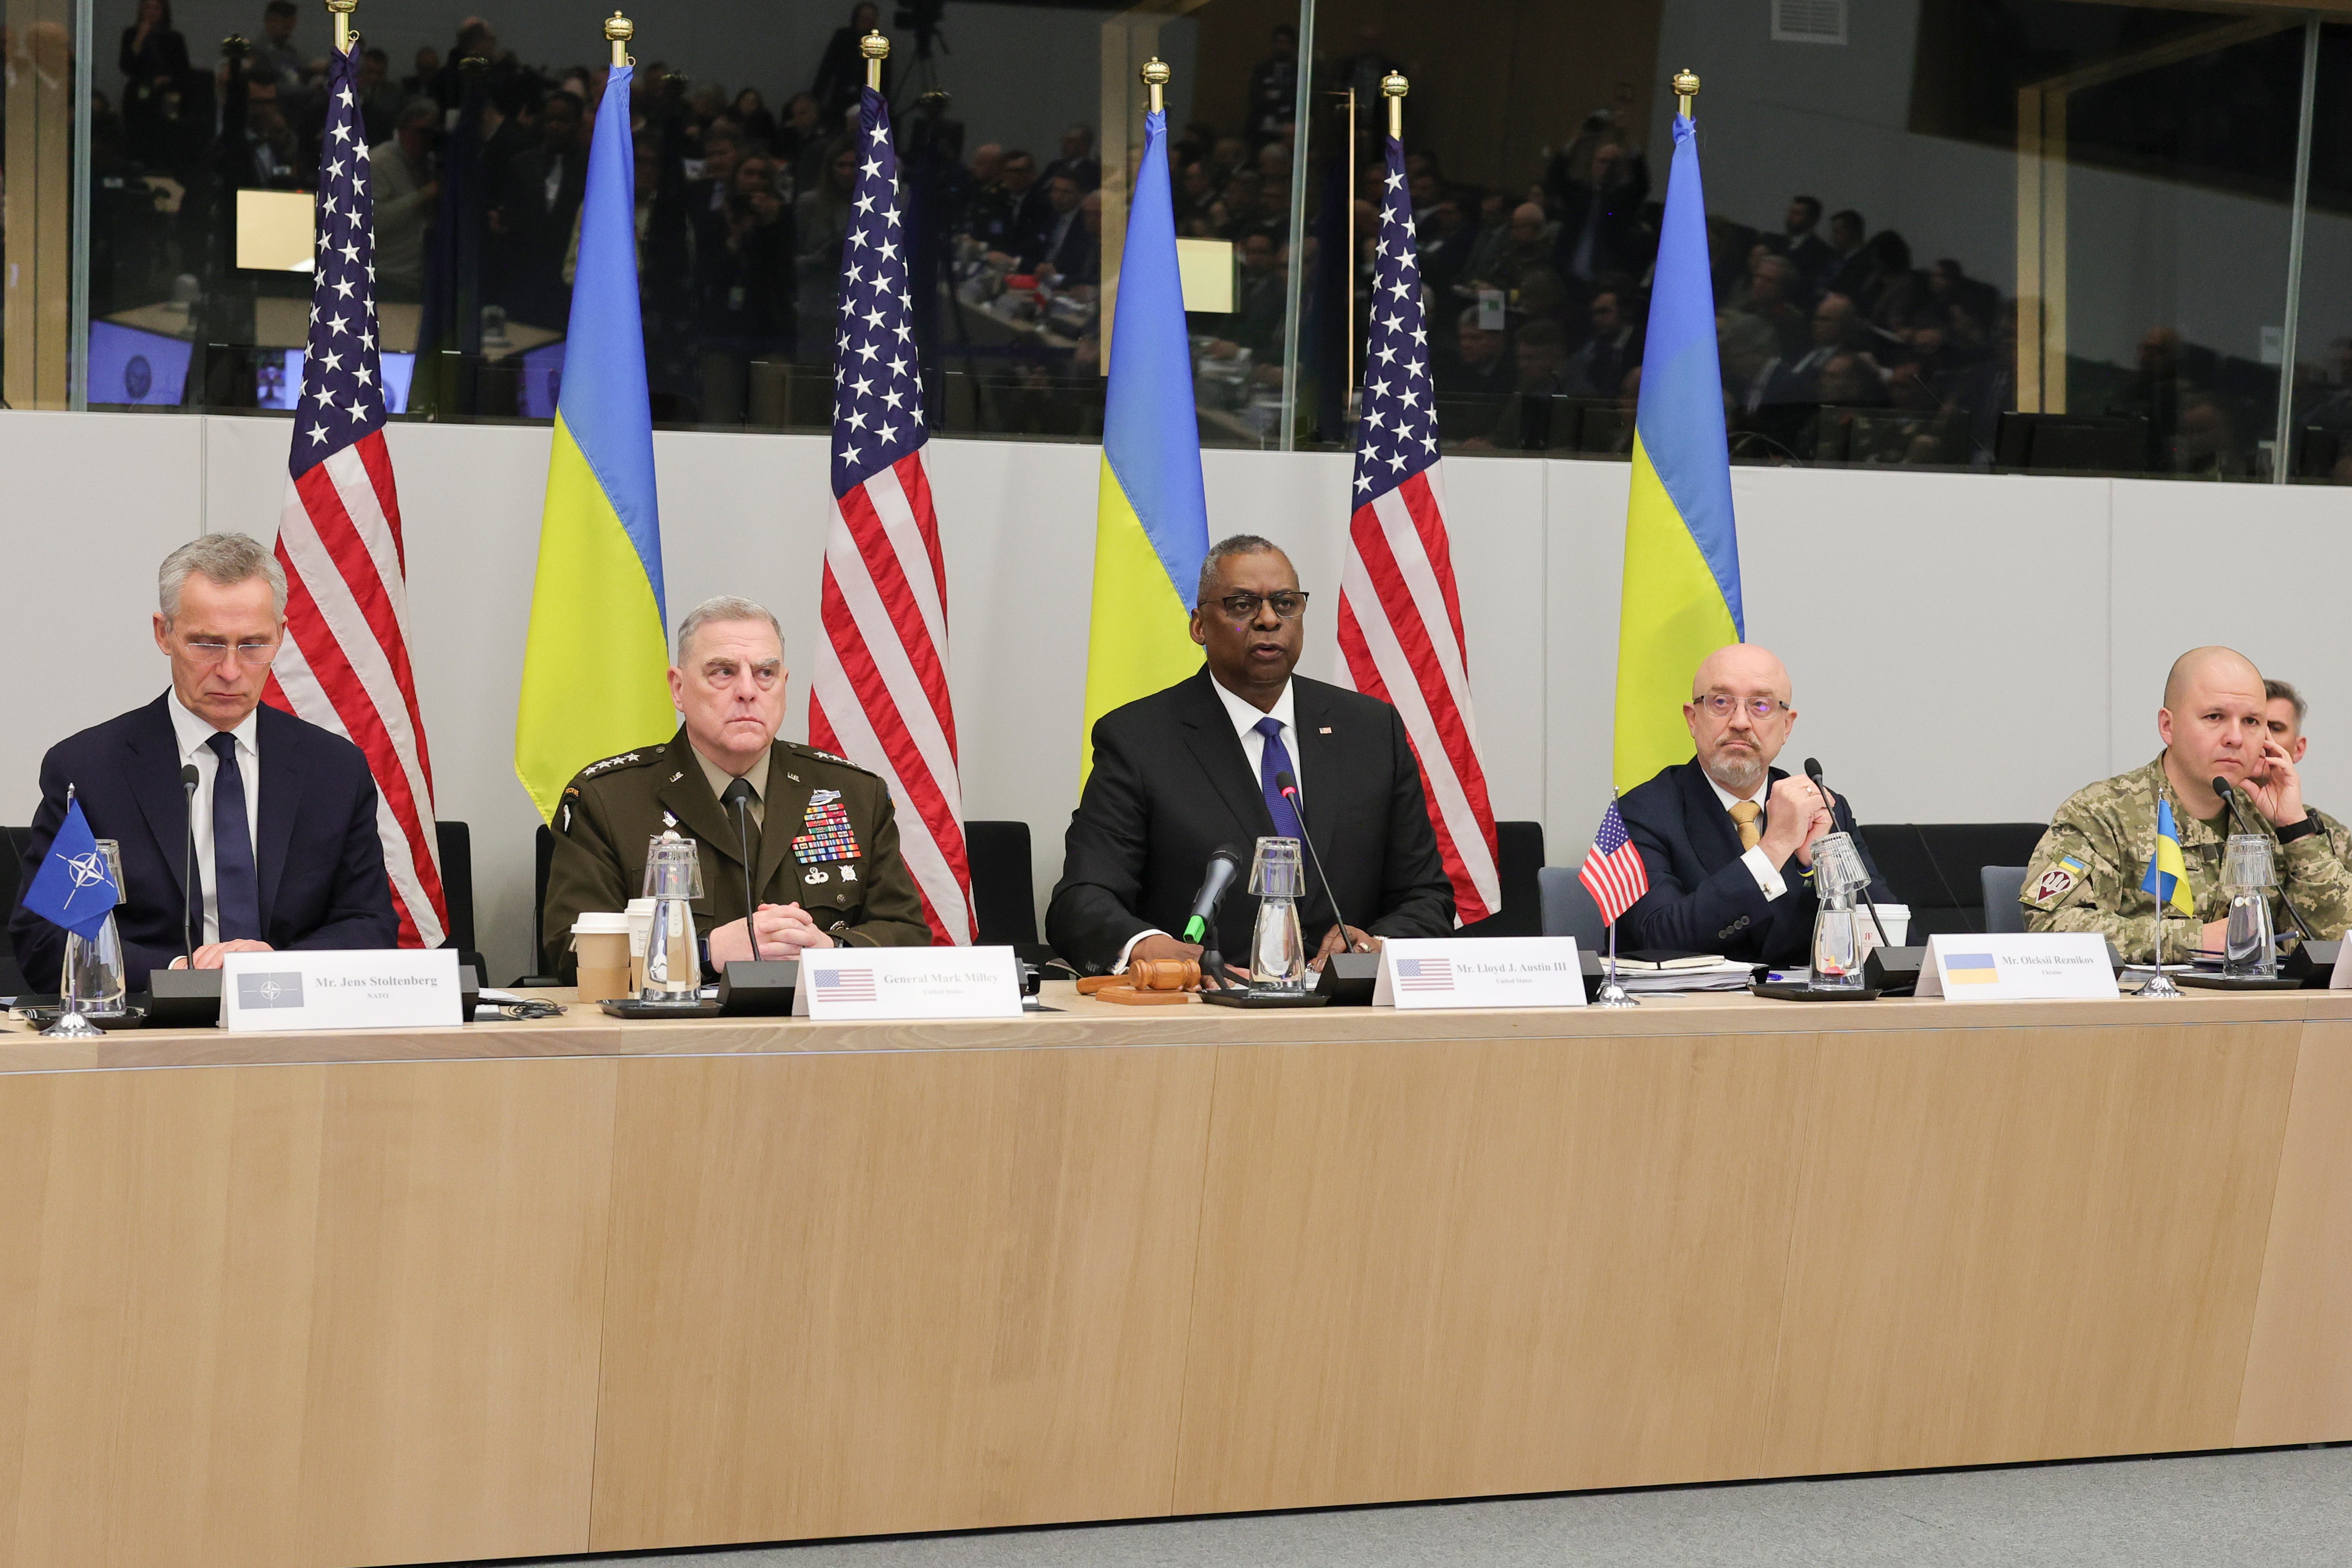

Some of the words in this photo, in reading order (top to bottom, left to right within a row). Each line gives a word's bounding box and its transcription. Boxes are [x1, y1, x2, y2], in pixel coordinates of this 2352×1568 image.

[2021, 956, 2052, 965] Oleksii
[2054, 956, 2095, 964] Reznikov
[1457, 964, 1475, 973] Mr.
[1477, 964, 1505, 974] Lloyd
[1509, 963, 1517, 972] J.
[1520, 963, 1551, 971] Austin
[1553, 962, 1567, 971] III
[315, 978, 337, 987] Mr.
[340, 977, 367, 987] Jens
[370, 975, 438, 987] Stoltenberg
[884, 974, 928, 983] General
[931, 973, 962, 983] Mark
[965, 972, 998, 984] Milley
